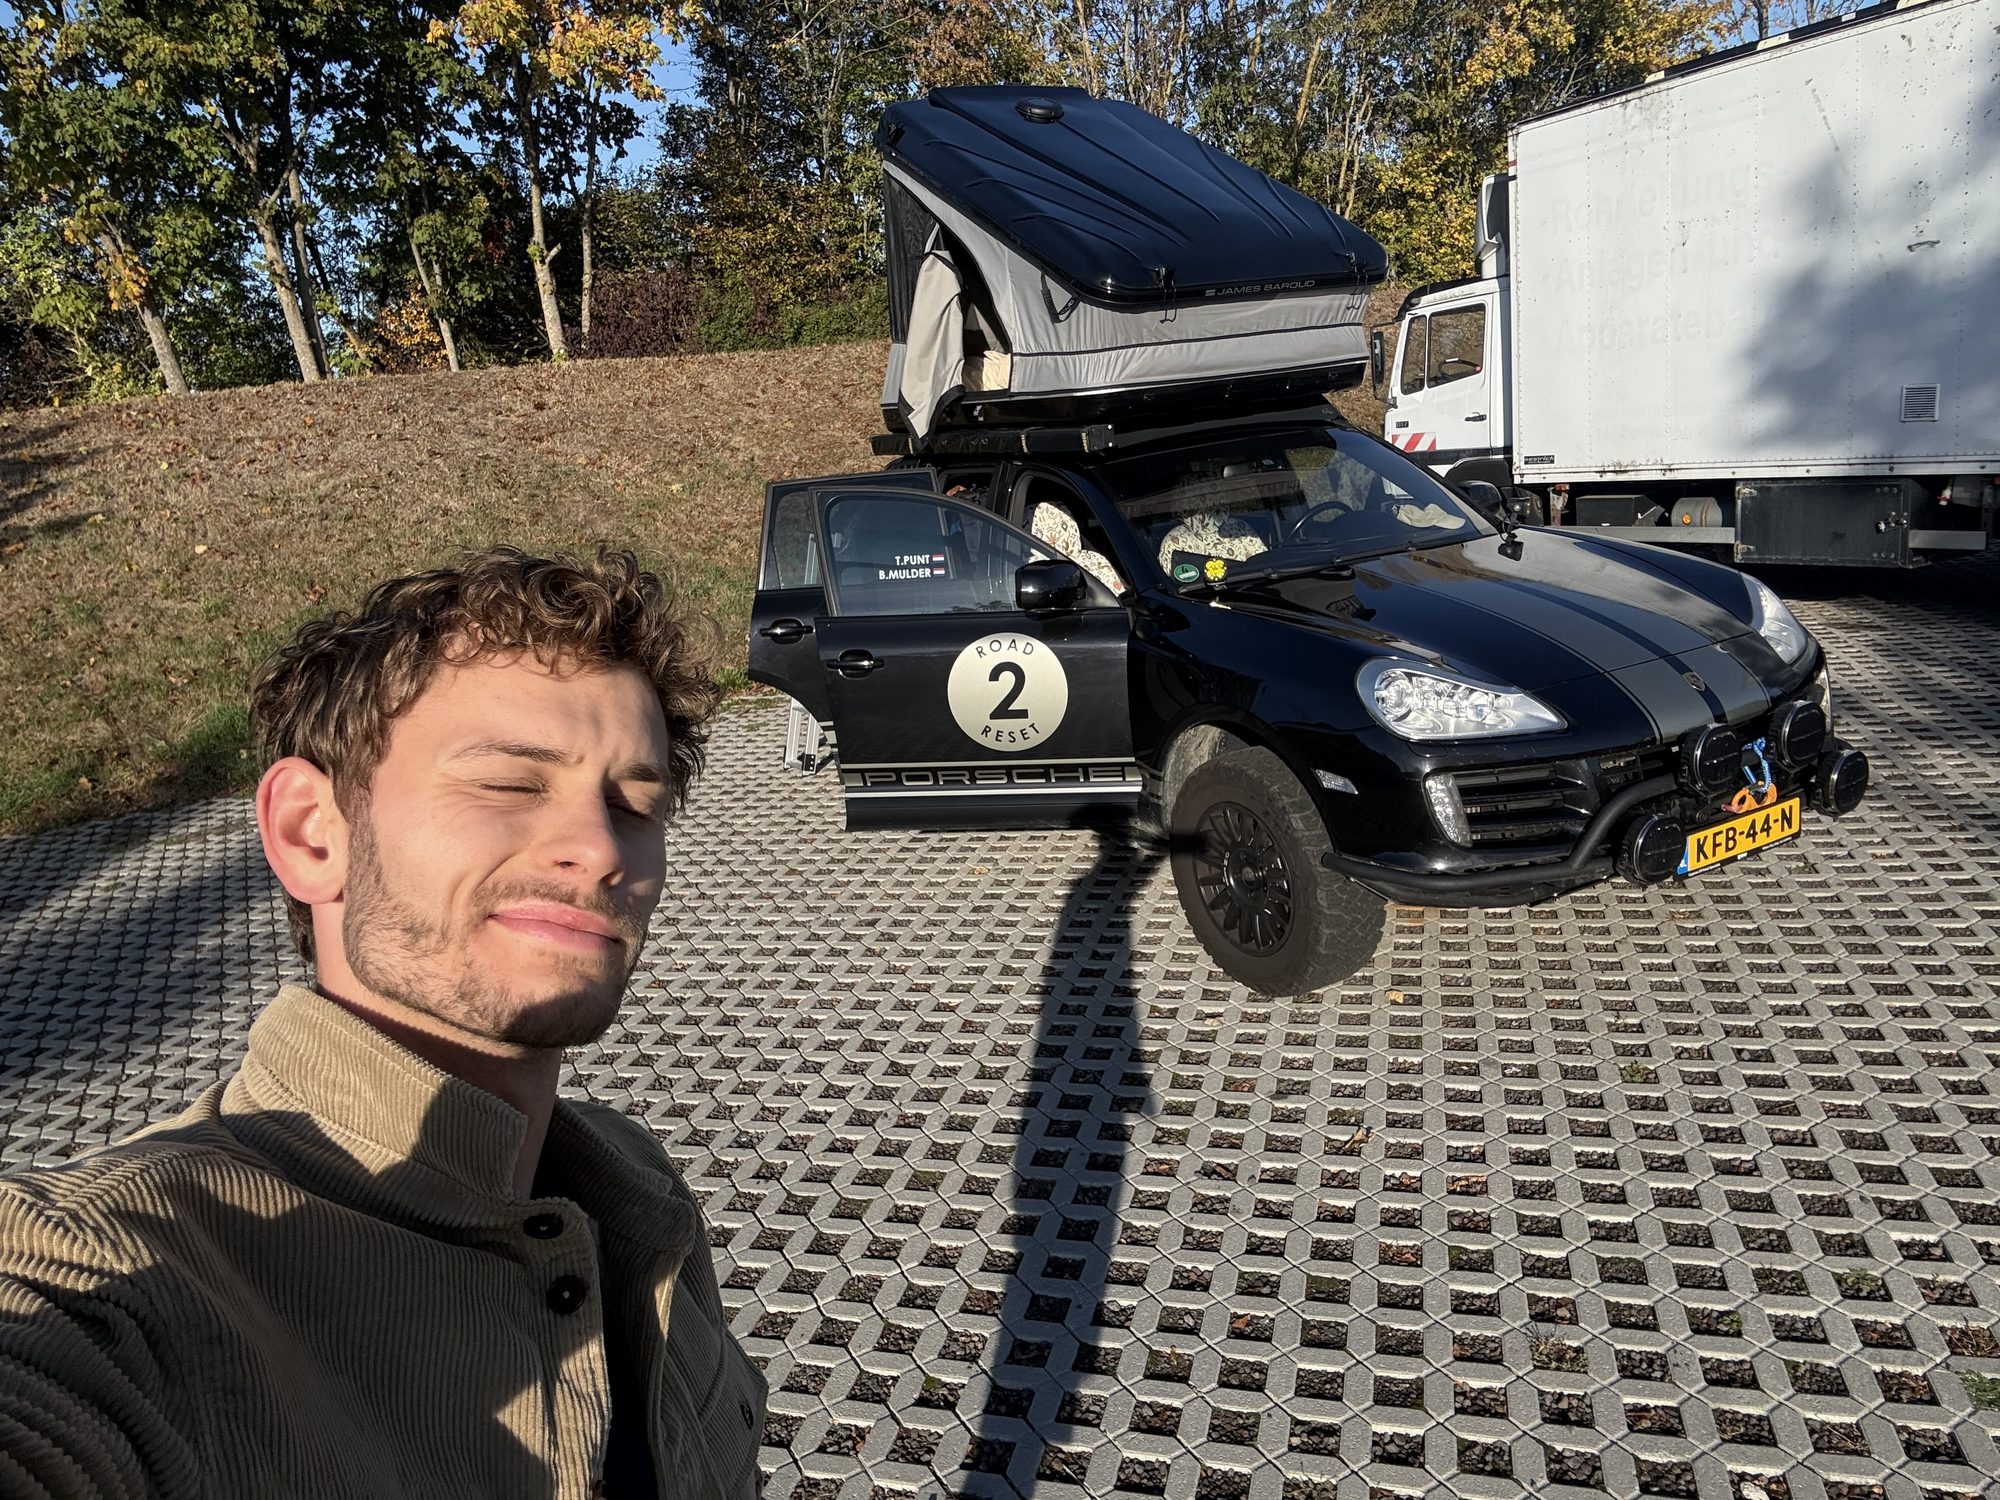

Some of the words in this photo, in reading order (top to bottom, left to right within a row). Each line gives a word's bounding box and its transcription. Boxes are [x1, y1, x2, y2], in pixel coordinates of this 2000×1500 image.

[1551, 160, 1790, 236] Rohrletungs-
[1217, 285, 1261, 296] JAMES
[1264, 280, 1315, 292] BAROUD
[1555, 303, 1752, 361] Apparateba
[894, 554, 930, 566] T.PUNT
[879, 568, 931, 580] B.MULDER
[975, 638, 1035, 659] ROAD
[988, 661, 1029, 720] 2
[980, 722, 1040, 743] RESET
[865, 766, 1123, 786] PORSCHE
[1696, 805, 1793, 863] KFB-44-N
